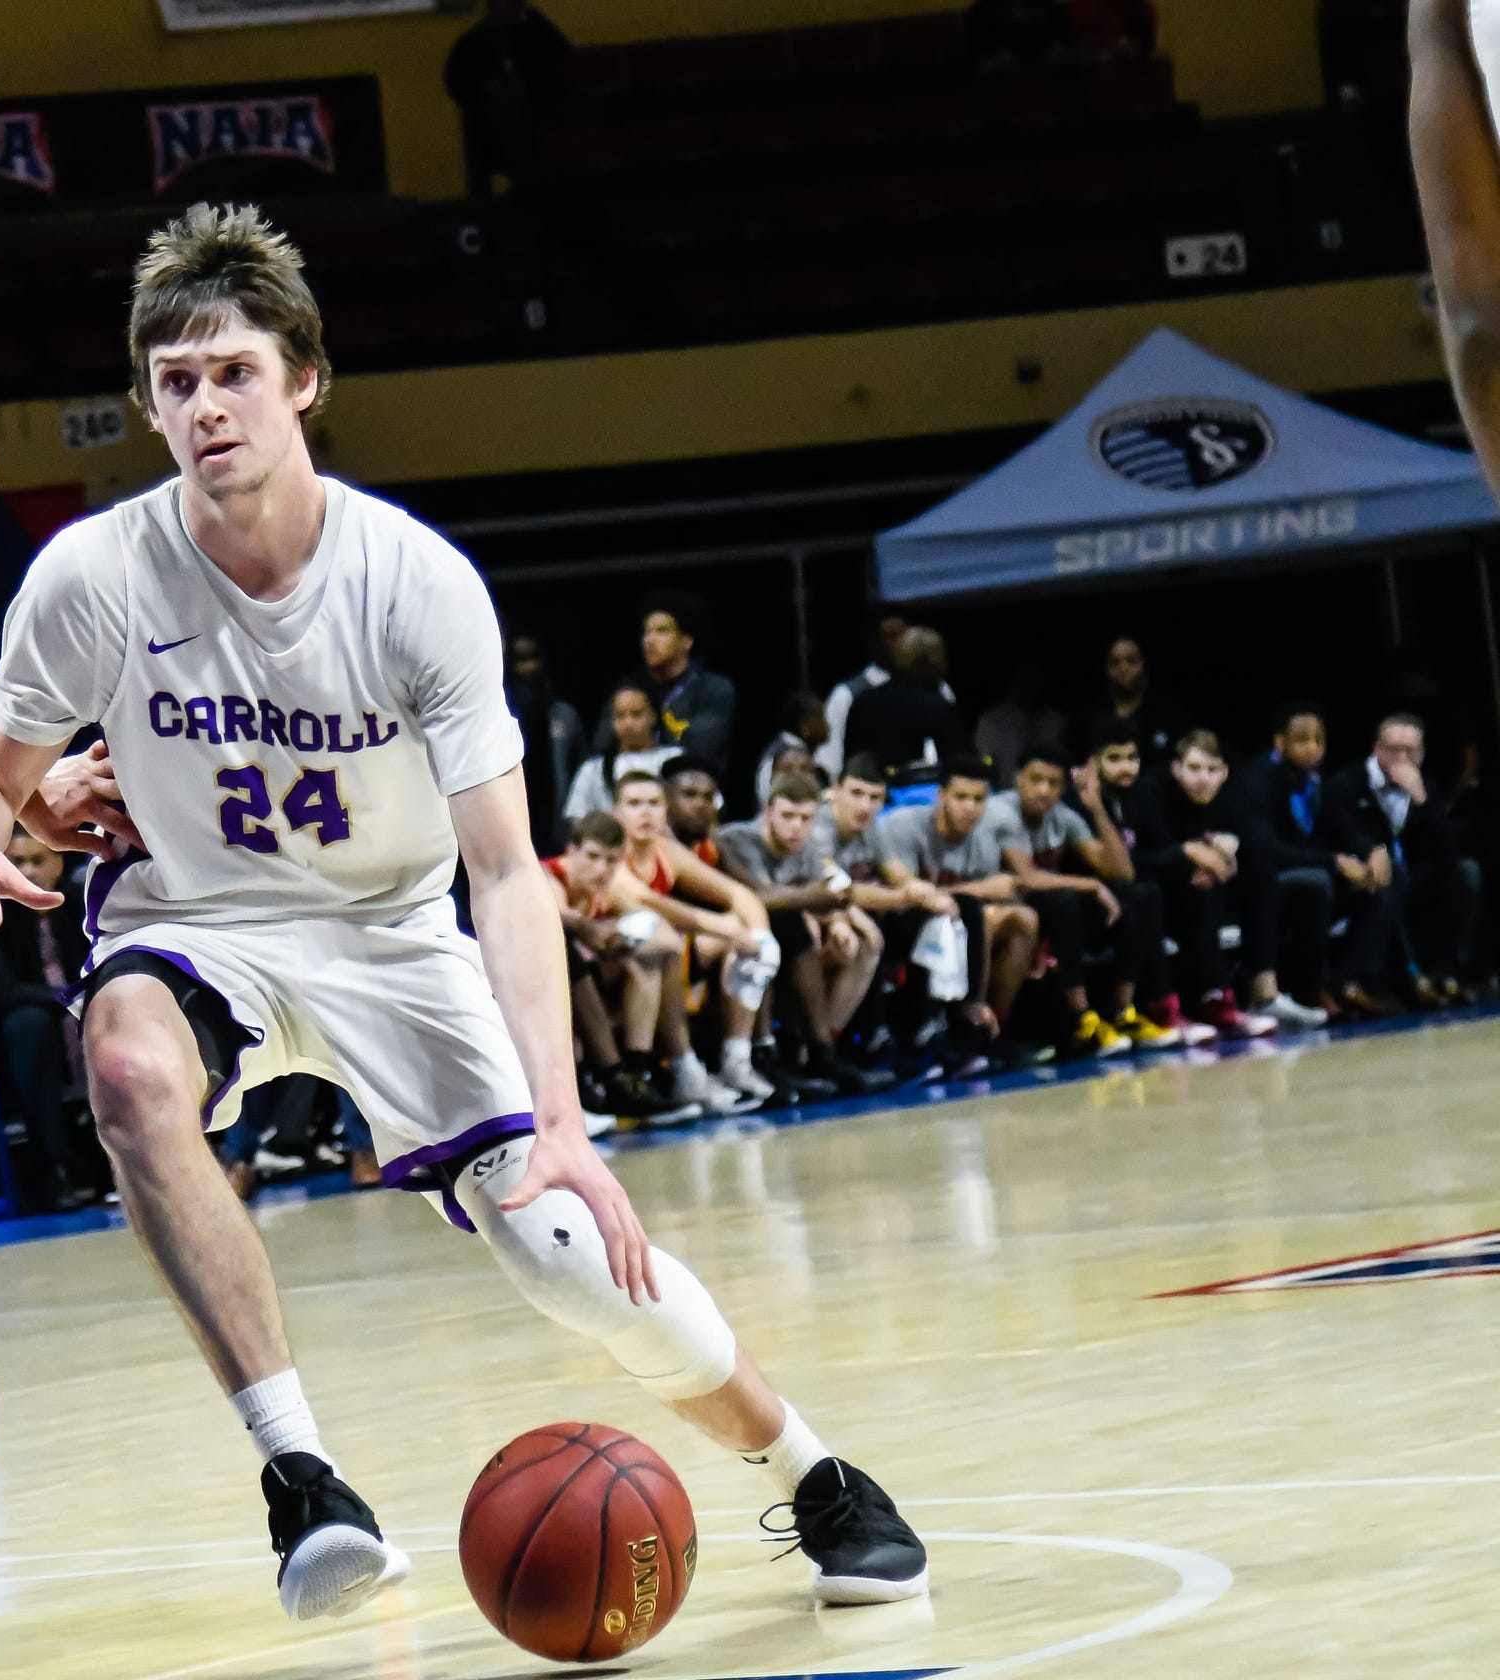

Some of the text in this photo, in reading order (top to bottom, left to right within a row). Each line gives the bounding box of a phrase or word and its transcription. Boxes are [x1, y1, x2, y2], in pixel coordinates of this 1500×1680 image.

[150, 101, 334, 184] NAIA
[1053, 501, 1358, 575] SPORTING
[149, 691, 399, 753] CARROLL
[213, 760, 355, 857] 24
